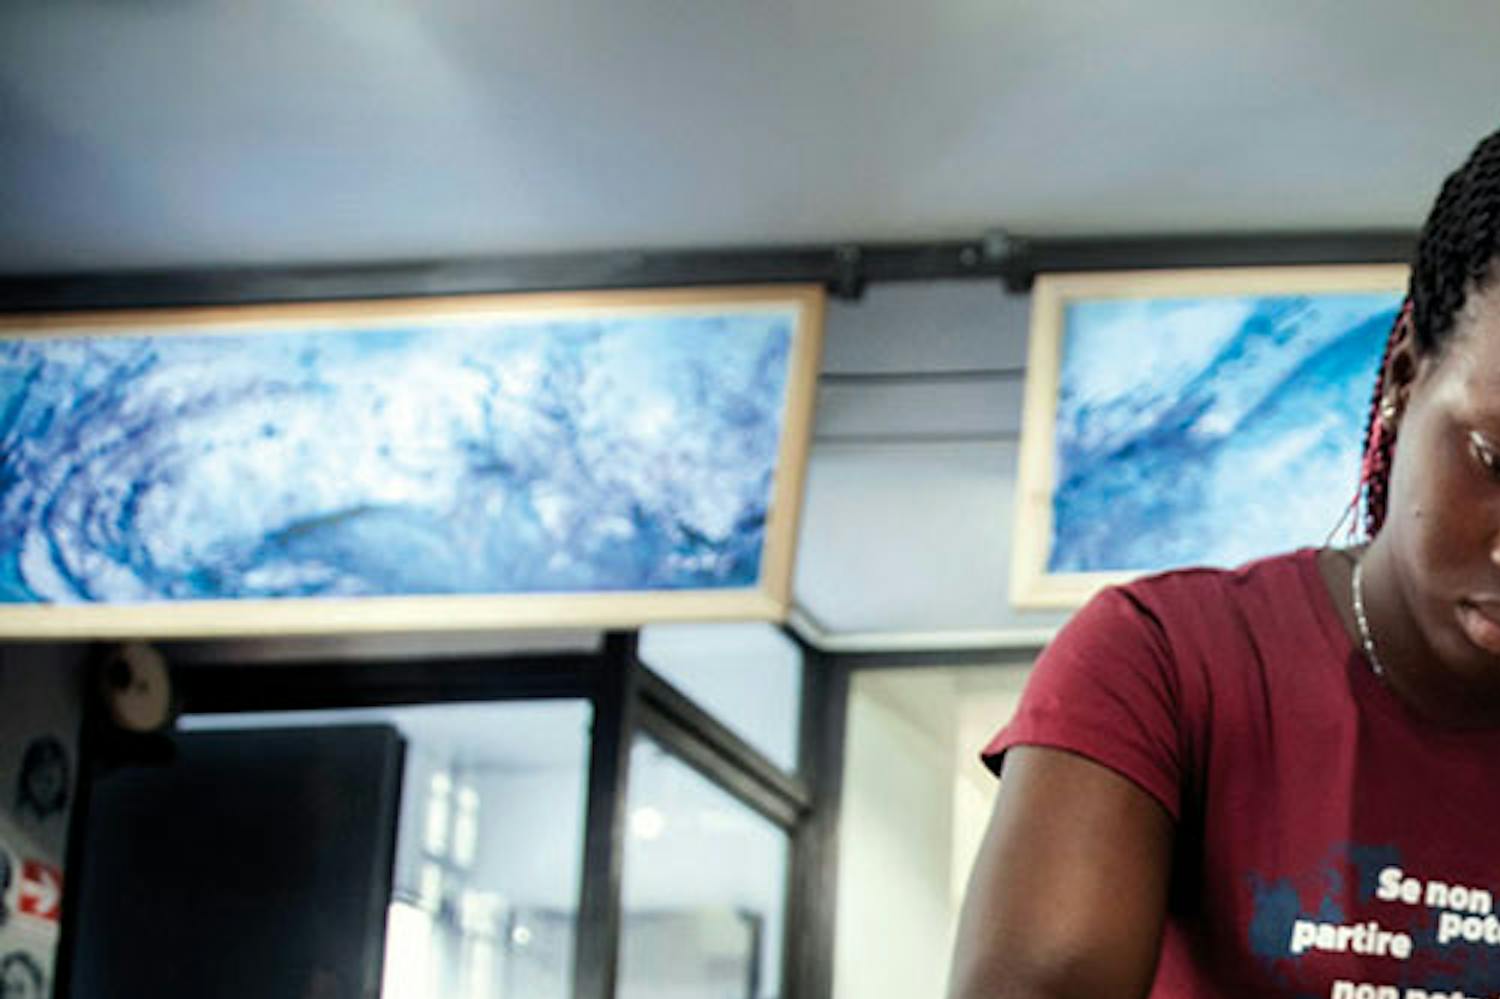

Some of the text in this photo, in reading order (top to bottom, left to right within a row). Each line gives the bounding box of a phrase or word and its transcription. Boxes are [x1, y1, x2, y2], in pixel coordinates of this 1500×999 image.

[1376, 867, 1493, 915] Se non
[1290, 919, 1413, 959] partire
